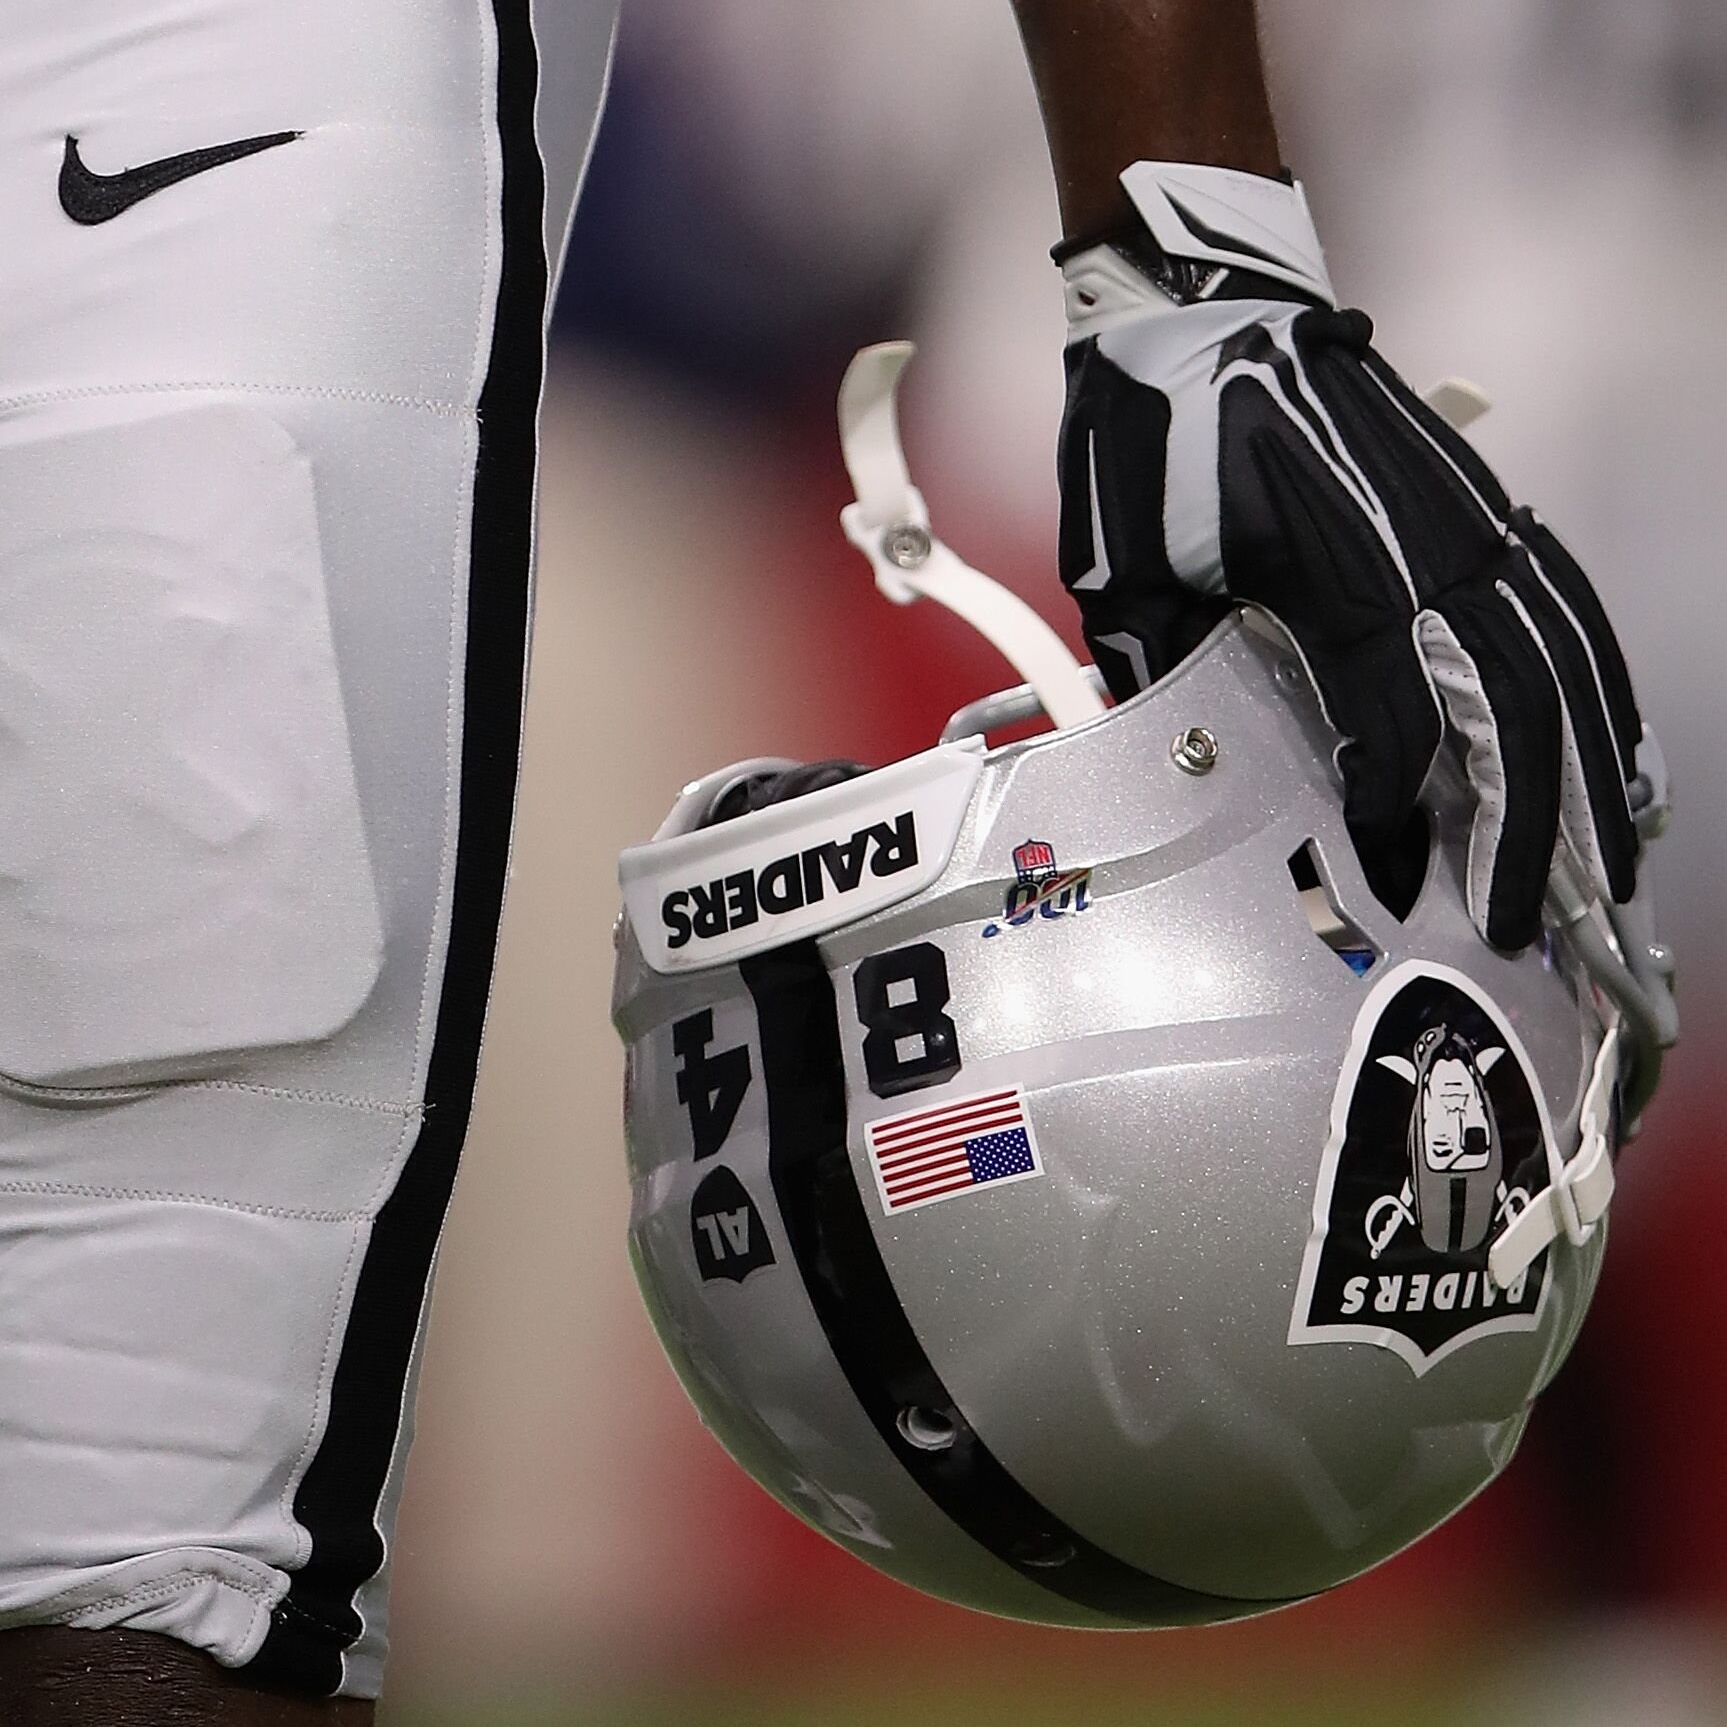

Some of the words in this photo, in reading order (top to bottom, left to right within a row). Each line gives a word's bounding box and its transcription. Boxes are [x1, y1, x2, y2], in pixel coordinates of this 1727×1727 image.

[661, 810, 920, 949] RAIDERS
[1017, 844, 1052, 868] NFL
[696, 1205, 750, 1261] AL
